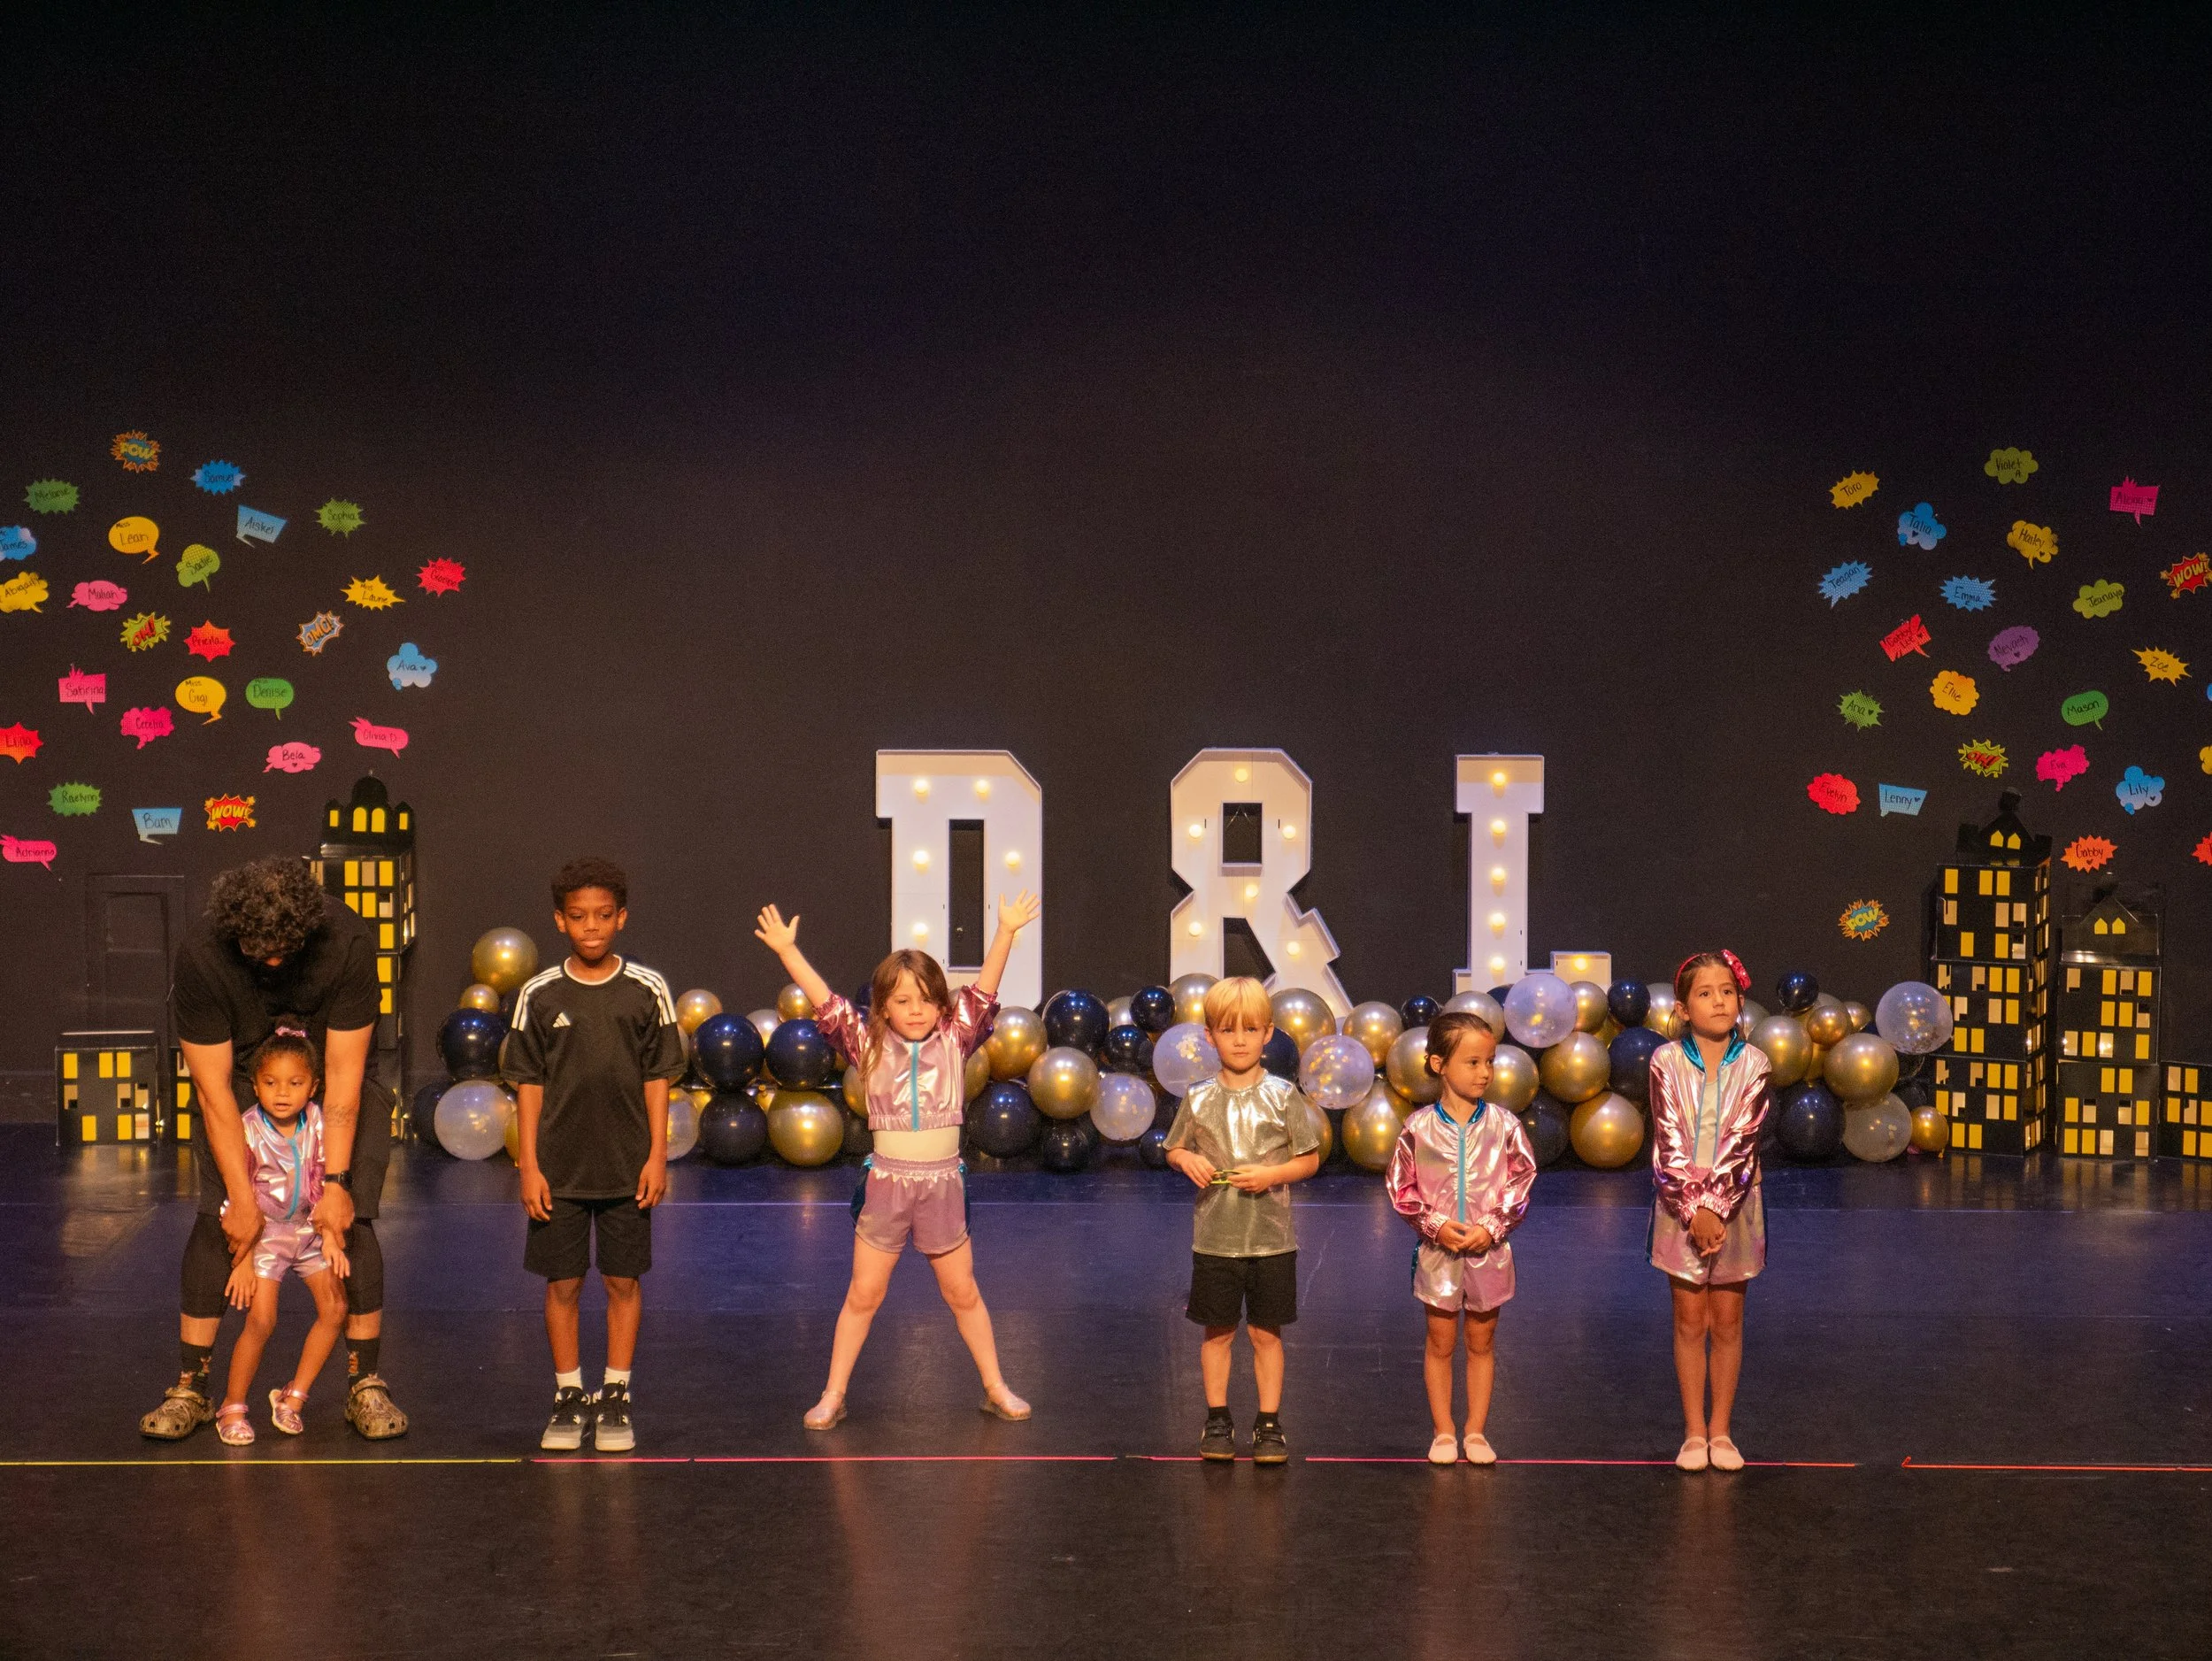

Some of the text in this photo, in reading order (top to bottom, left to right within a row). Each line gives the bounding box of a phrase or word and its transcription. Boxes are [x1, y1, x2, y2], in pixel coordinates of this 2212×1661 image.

[120, 442, 156, 459] POW
[1995, 458, 2022, 471] Violet
[2173, 560, 2208, 588] WOW!
[1954, 586, 1982, 603] Emma
[132, 617, 156, 646] OH!
[305, 611, 334, 647] OMG!
[396, 660, 418, 671] Ava
[253, 684, 287, 697] Denise
[2066, 700, 2100, 716] Mason
[1967, 750, 2000, 770] OH!
[2129, 783, 2149, 797] Lily
[1884, 790, 1913, 811] Lenny
[211, 804, 249, 820] WOW!
[2076, 843, 2104, 860] Gabby
[876, 747, 1611, 1009] D & L
[1846, 907, 1879, 931] POW
